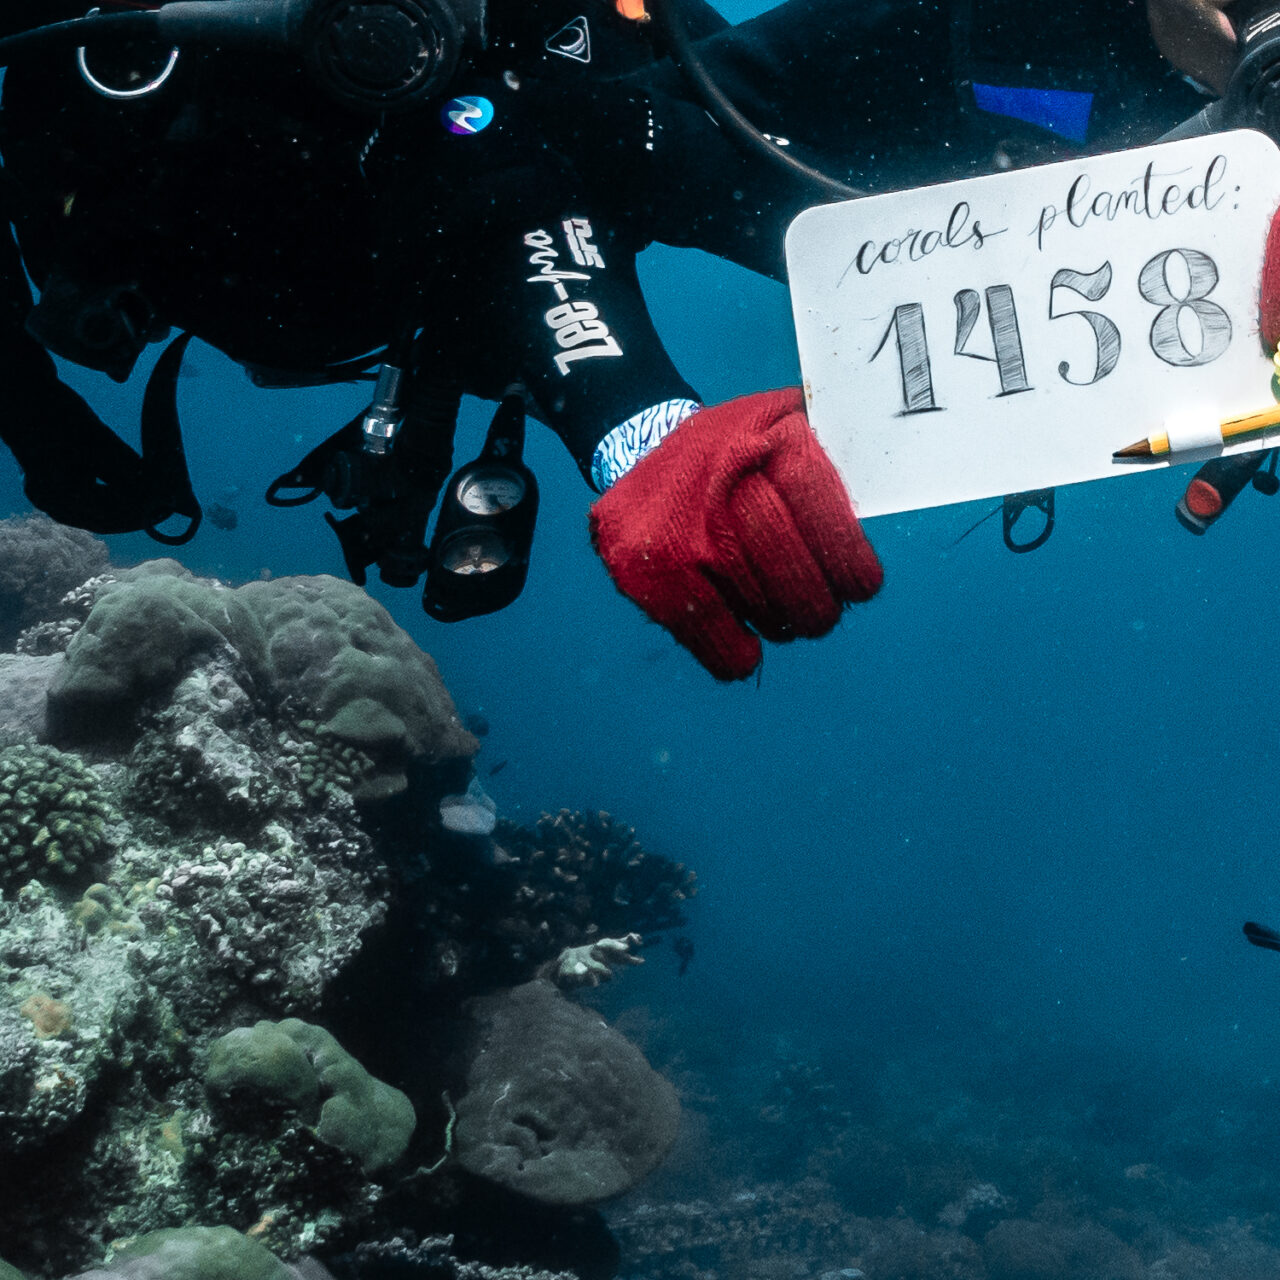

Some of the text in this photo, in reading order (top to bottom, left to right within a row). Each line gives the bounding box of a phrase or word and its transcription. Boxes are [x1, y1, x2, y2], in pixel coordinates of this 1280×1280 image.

[837, 154, 1241, 288] corals planted:
[868, 248, 1233, 417] 1458
